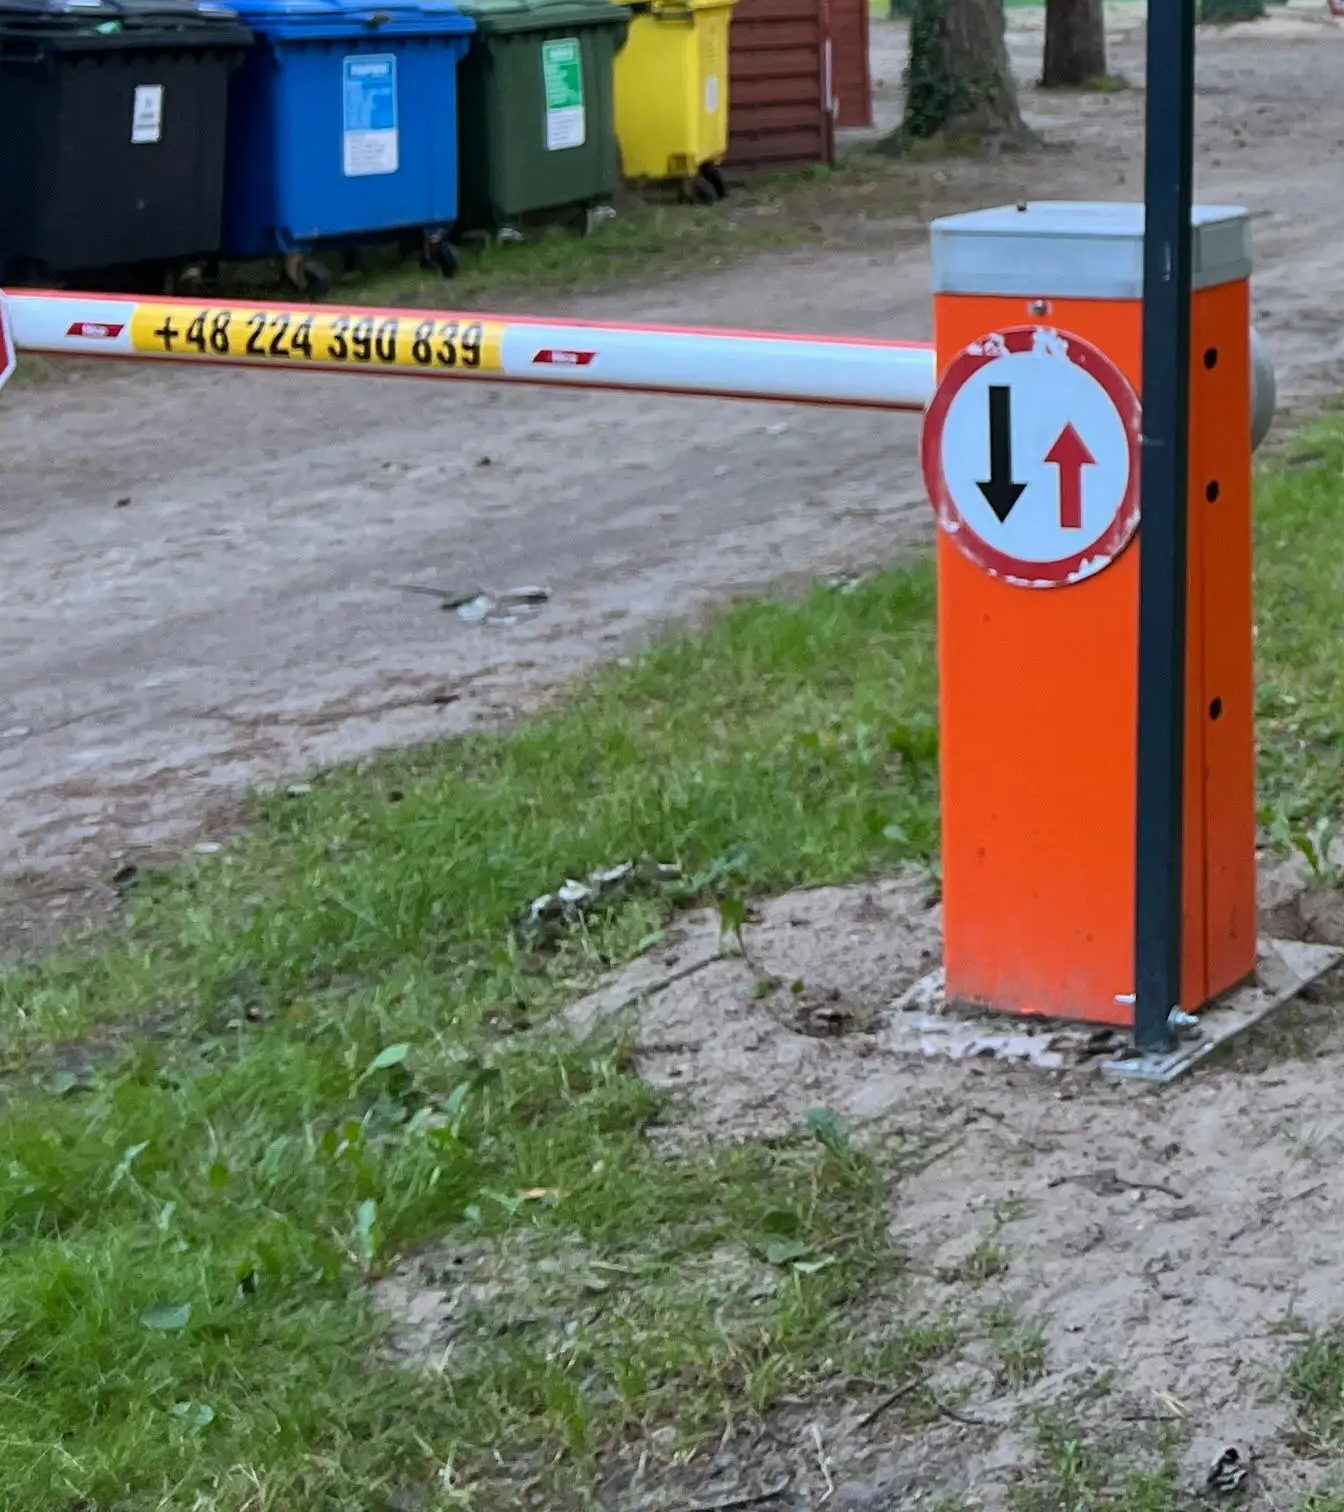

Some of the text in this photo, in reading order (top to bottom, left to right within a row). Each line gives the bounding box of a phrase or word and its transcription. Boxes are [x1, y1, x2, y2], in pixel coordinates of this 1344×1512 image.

[154, 307, 484, 369] +48 224 390 839
